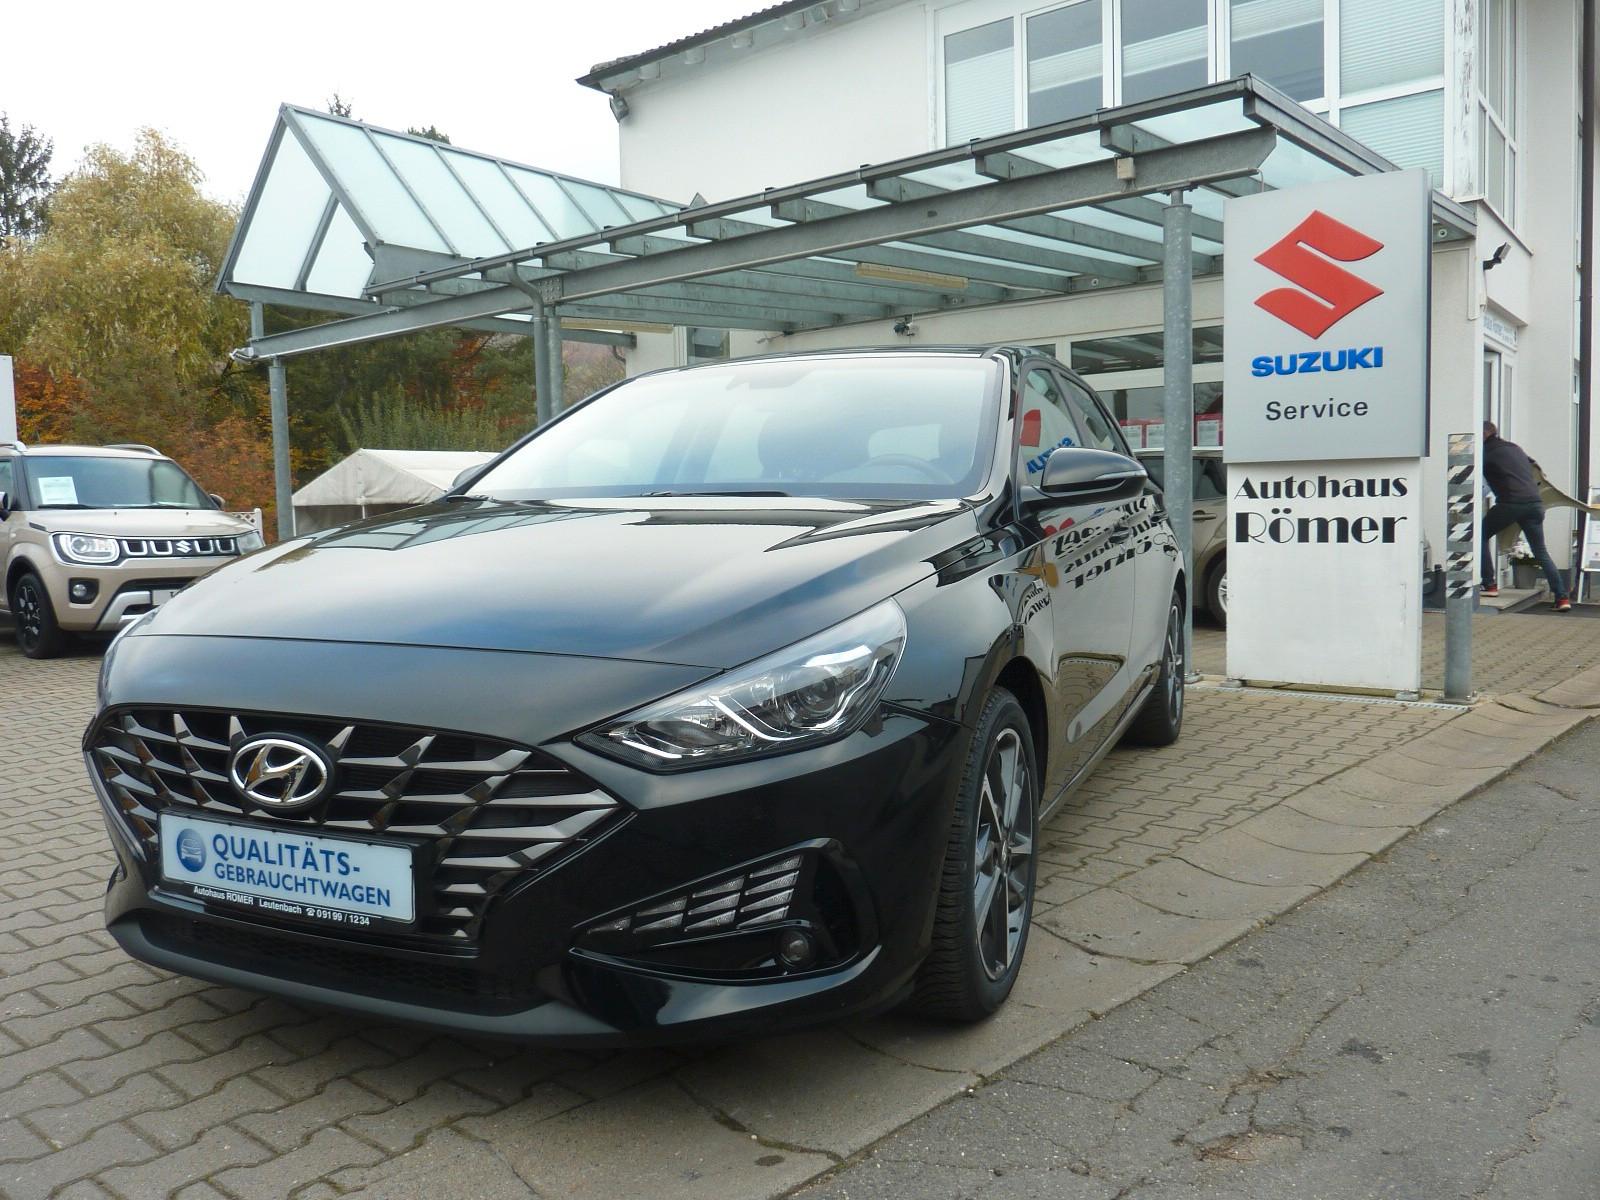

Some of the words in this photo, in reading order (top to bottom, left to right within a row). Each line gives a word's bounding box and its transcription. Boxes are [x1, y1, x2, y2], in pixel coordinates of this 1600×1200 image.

[1251, 346, 1384, 378] SUZUKI
[1265, 397, 1369, 421] Service
[1234, 475, 1408, 500] Autohaus
[1235, 507, 1408, 544] Römer
[212, 833, 360, 876] QUALITÄTS-
[214, 862, 391, 907] GEBRAUCHTWAGEN
[193, 885, 226, 900] Autohaus
[259, 898, 302, 914] Leutenbach
[349, 914, 370, 926] 1234
